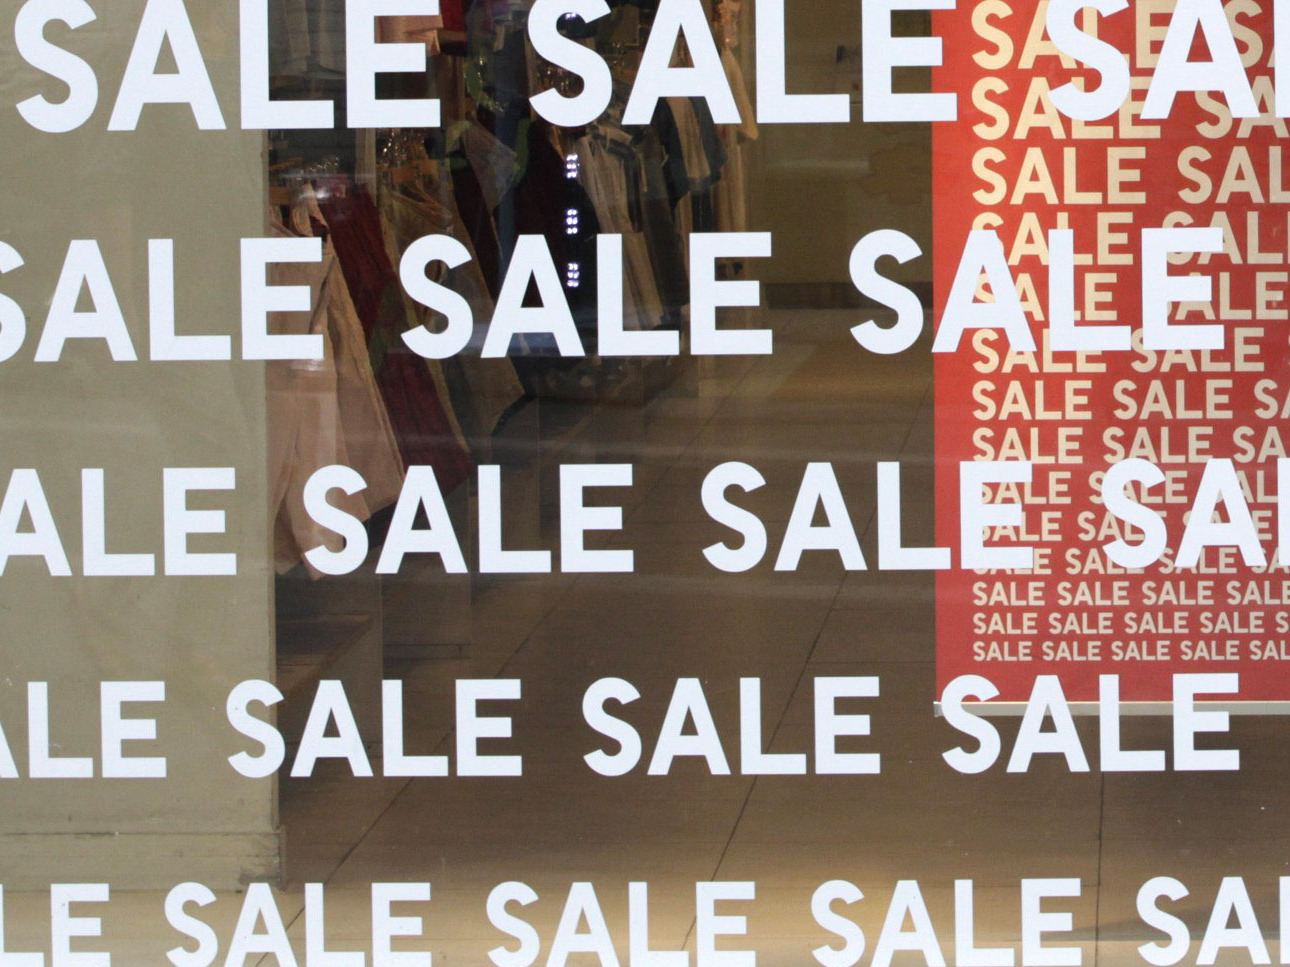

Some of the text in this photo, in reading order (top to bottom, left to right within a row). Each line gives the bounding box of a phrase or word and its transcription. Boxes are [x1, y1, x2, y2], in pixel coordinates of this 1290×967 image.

[972, 76, 1161, 140] SALE
[972, 146, 1146, 205] SALE
[400, 232, 772, 359] SALE
[850, 228, 1224, 354] SALE
[972, 380, 1092, 421] SALE
[1113, 379, 1233, 420] SALE
[973, 427, 1084, 464] SALE
[1103, 426, 1213, 464] SALE
[304, 464, 633, 574] SALE
[702, 462, 1033, 572] SALE
[972, 581, 1046, 607] SALE
[1056, 581, 1130, 607] SALE
[1141, 580, 1215, 606] SALE
[972, 612, 1038, 635] SALE
[1048, 612, 1114, 635] SALE
[1123, 611, 1189, 634] SALE
[1199, 611, 1265, 634] SALE
[972, 641, 1032, 662] SALE
[1041, 641, 1102, 662] SALE
[1110, 640, 1170, 661] SALE
[1179, 640, 1240, 661] SALE
[0, 681, 166, 778] LE
[226, 679, 521, 778] SALE
[583, 677, 880, 776] SALE
[941, 674, 1239, 773] SALE
[166, 882, 432, 967] SALE
[487, 882, 756, 967] SALE
[812, 878, 1081, 967] SALE
